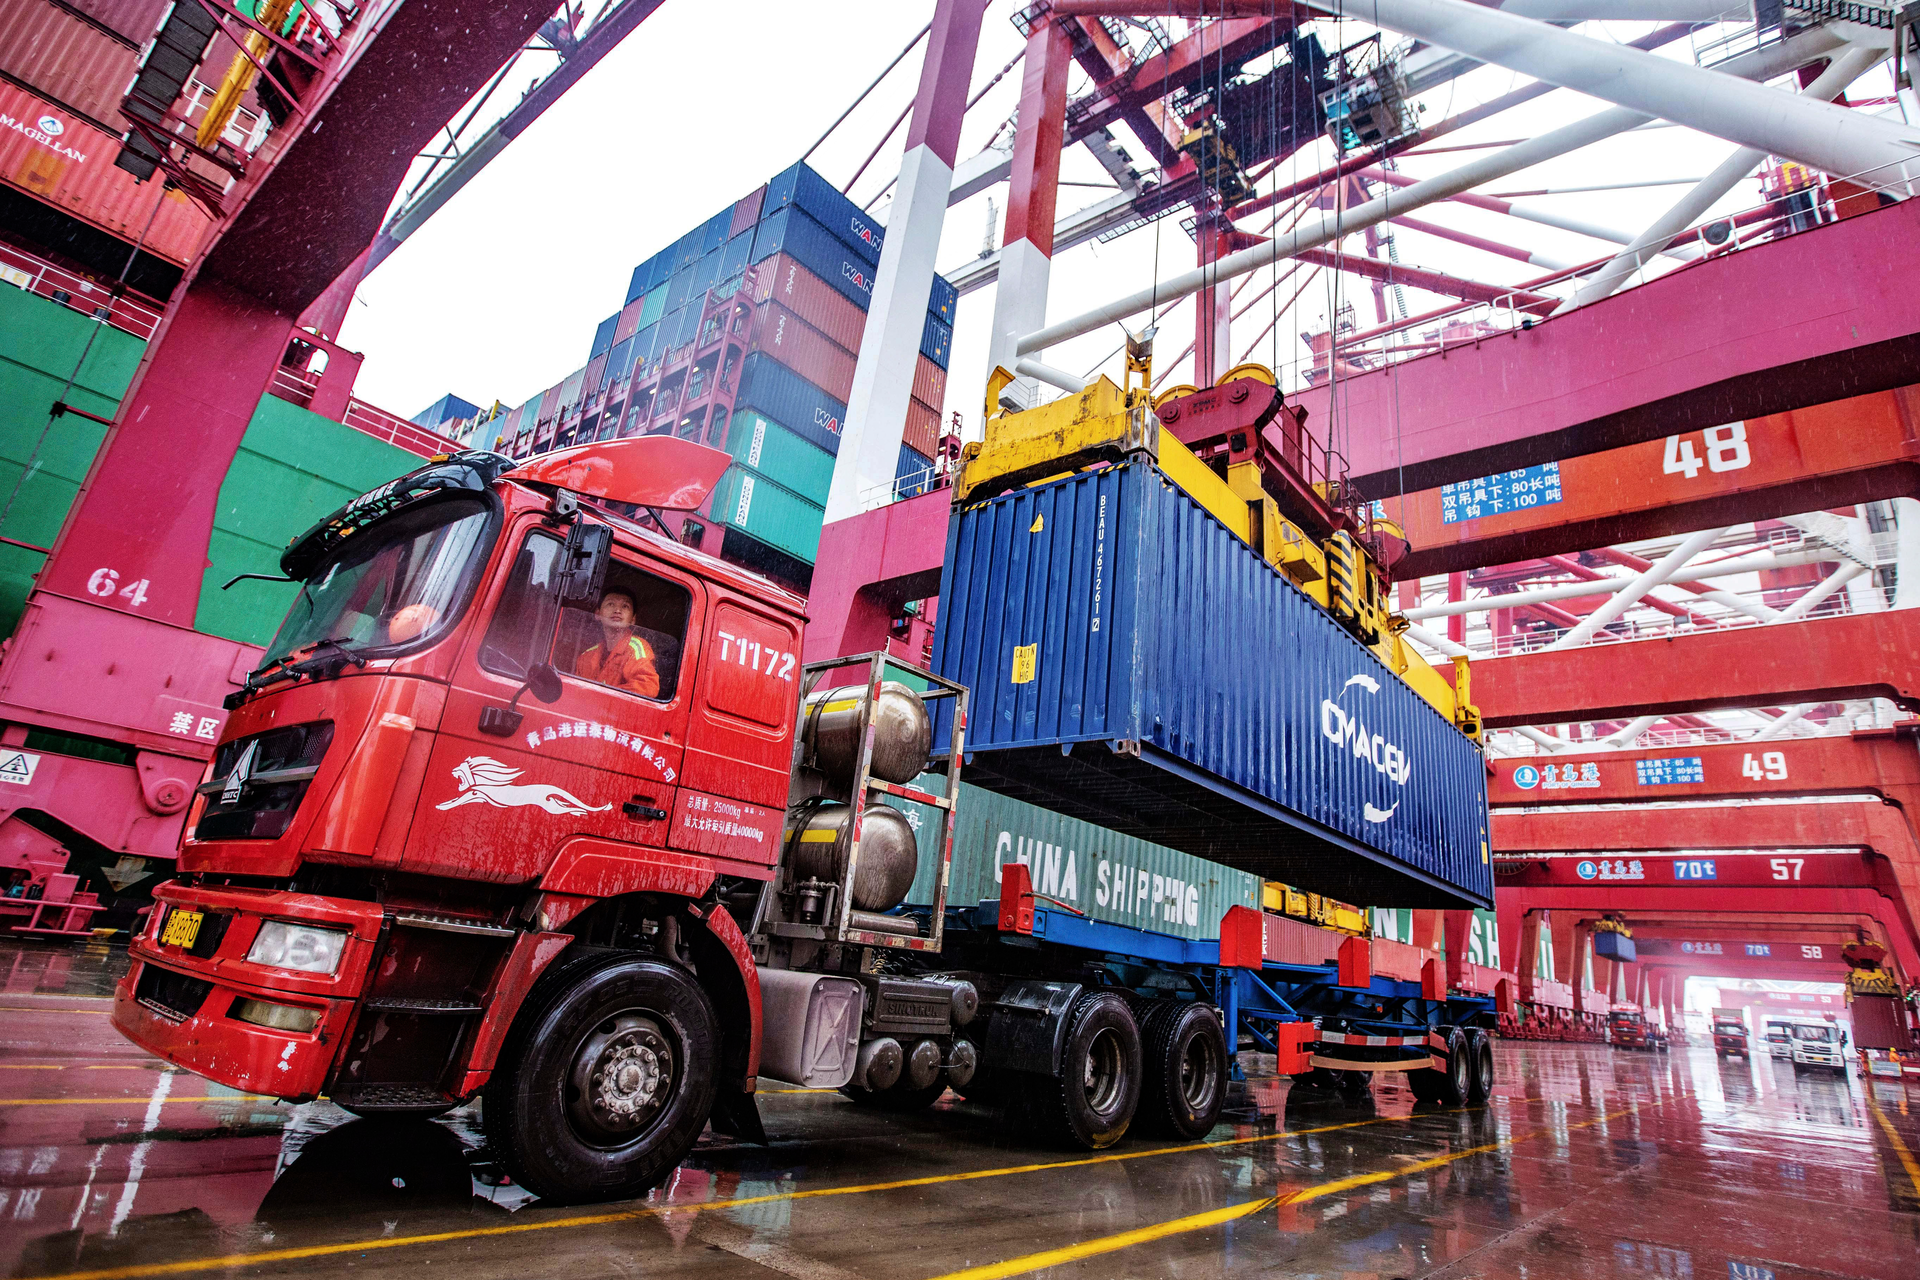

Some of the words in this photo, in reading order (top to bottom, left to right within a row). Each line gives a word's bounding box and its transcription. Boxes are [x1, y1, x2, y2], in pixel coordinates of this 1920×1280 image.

[0, 113, 87, 163] MAGELLAN
[851, 217, 883, 251] WAN
[842, 261, 874, 295] WAN
[1663, 420, 1751, 479] 48
[1098, 495, 1107, 540] BEAU
[87, 567, 150, 606] 64
[1094, 543, 1103, 614] 467261
[718, 630, 796, 682] T1172
[169, 711, 220, 739] 禁区
[1742, 751, 1788, 781] 49
[995, 831, 1077, 900] CHINA
[1096, 859, 1199, 927] SHIPPING
[1676, 861, 1715, 879] 70t
[1770, 858, 1804, 881] 57
[1747, 944, 1770, 956] 70t
[1801, 945, 1823, 959] 58
